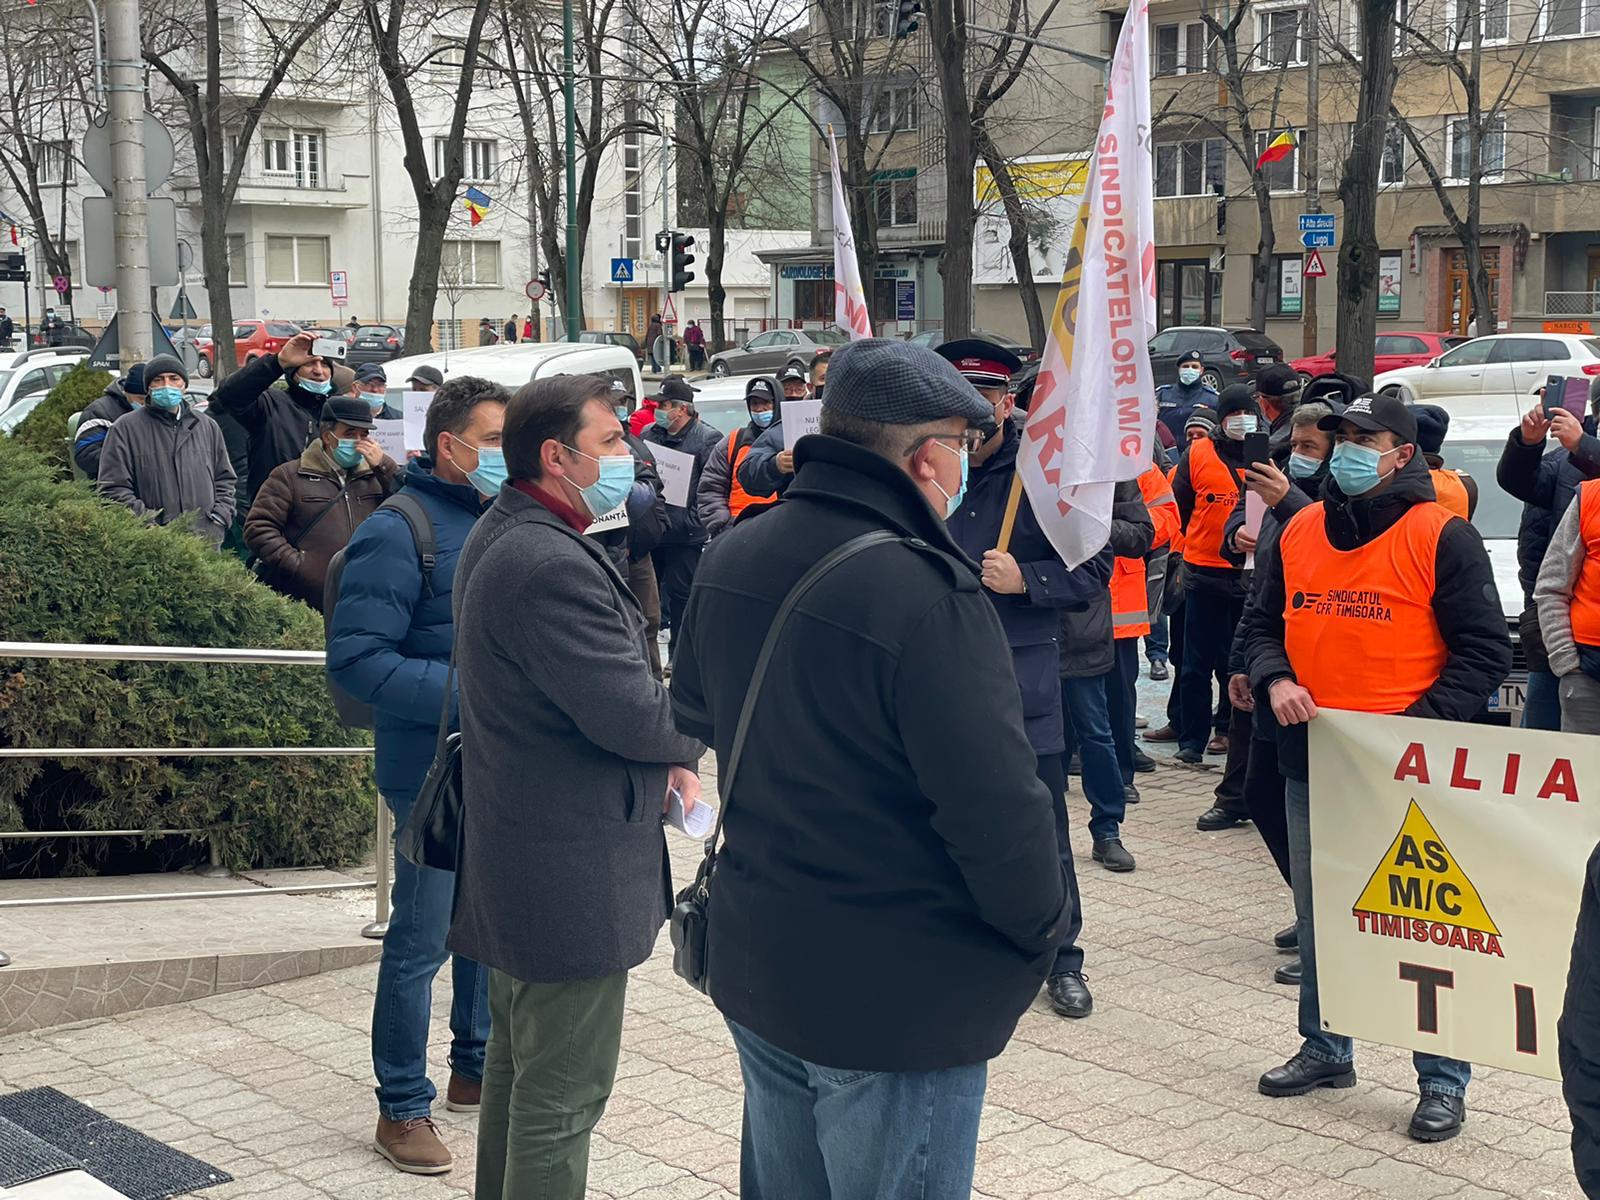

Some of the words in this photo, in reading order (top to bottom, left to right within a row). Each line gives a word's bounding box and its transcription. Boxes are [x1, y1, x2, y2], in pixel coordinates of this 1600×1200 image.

[1098, 133, 1137, 388] SINDICATELOR
[1312, 233, 1329, 247] Lugoj
[1116, 396, 1142, 458] M/C
[1315, 602, 1333, 615] CFR
[1335, 603, 1392, 621] TIMISOARA
[1326, 589, 1383, 606] SINDICATUL
[1394, 834, 1450, 874] AS
[1388, 873, 1463, 917] M/C
[1352, 908, 1506, 959] TIMISOARA
